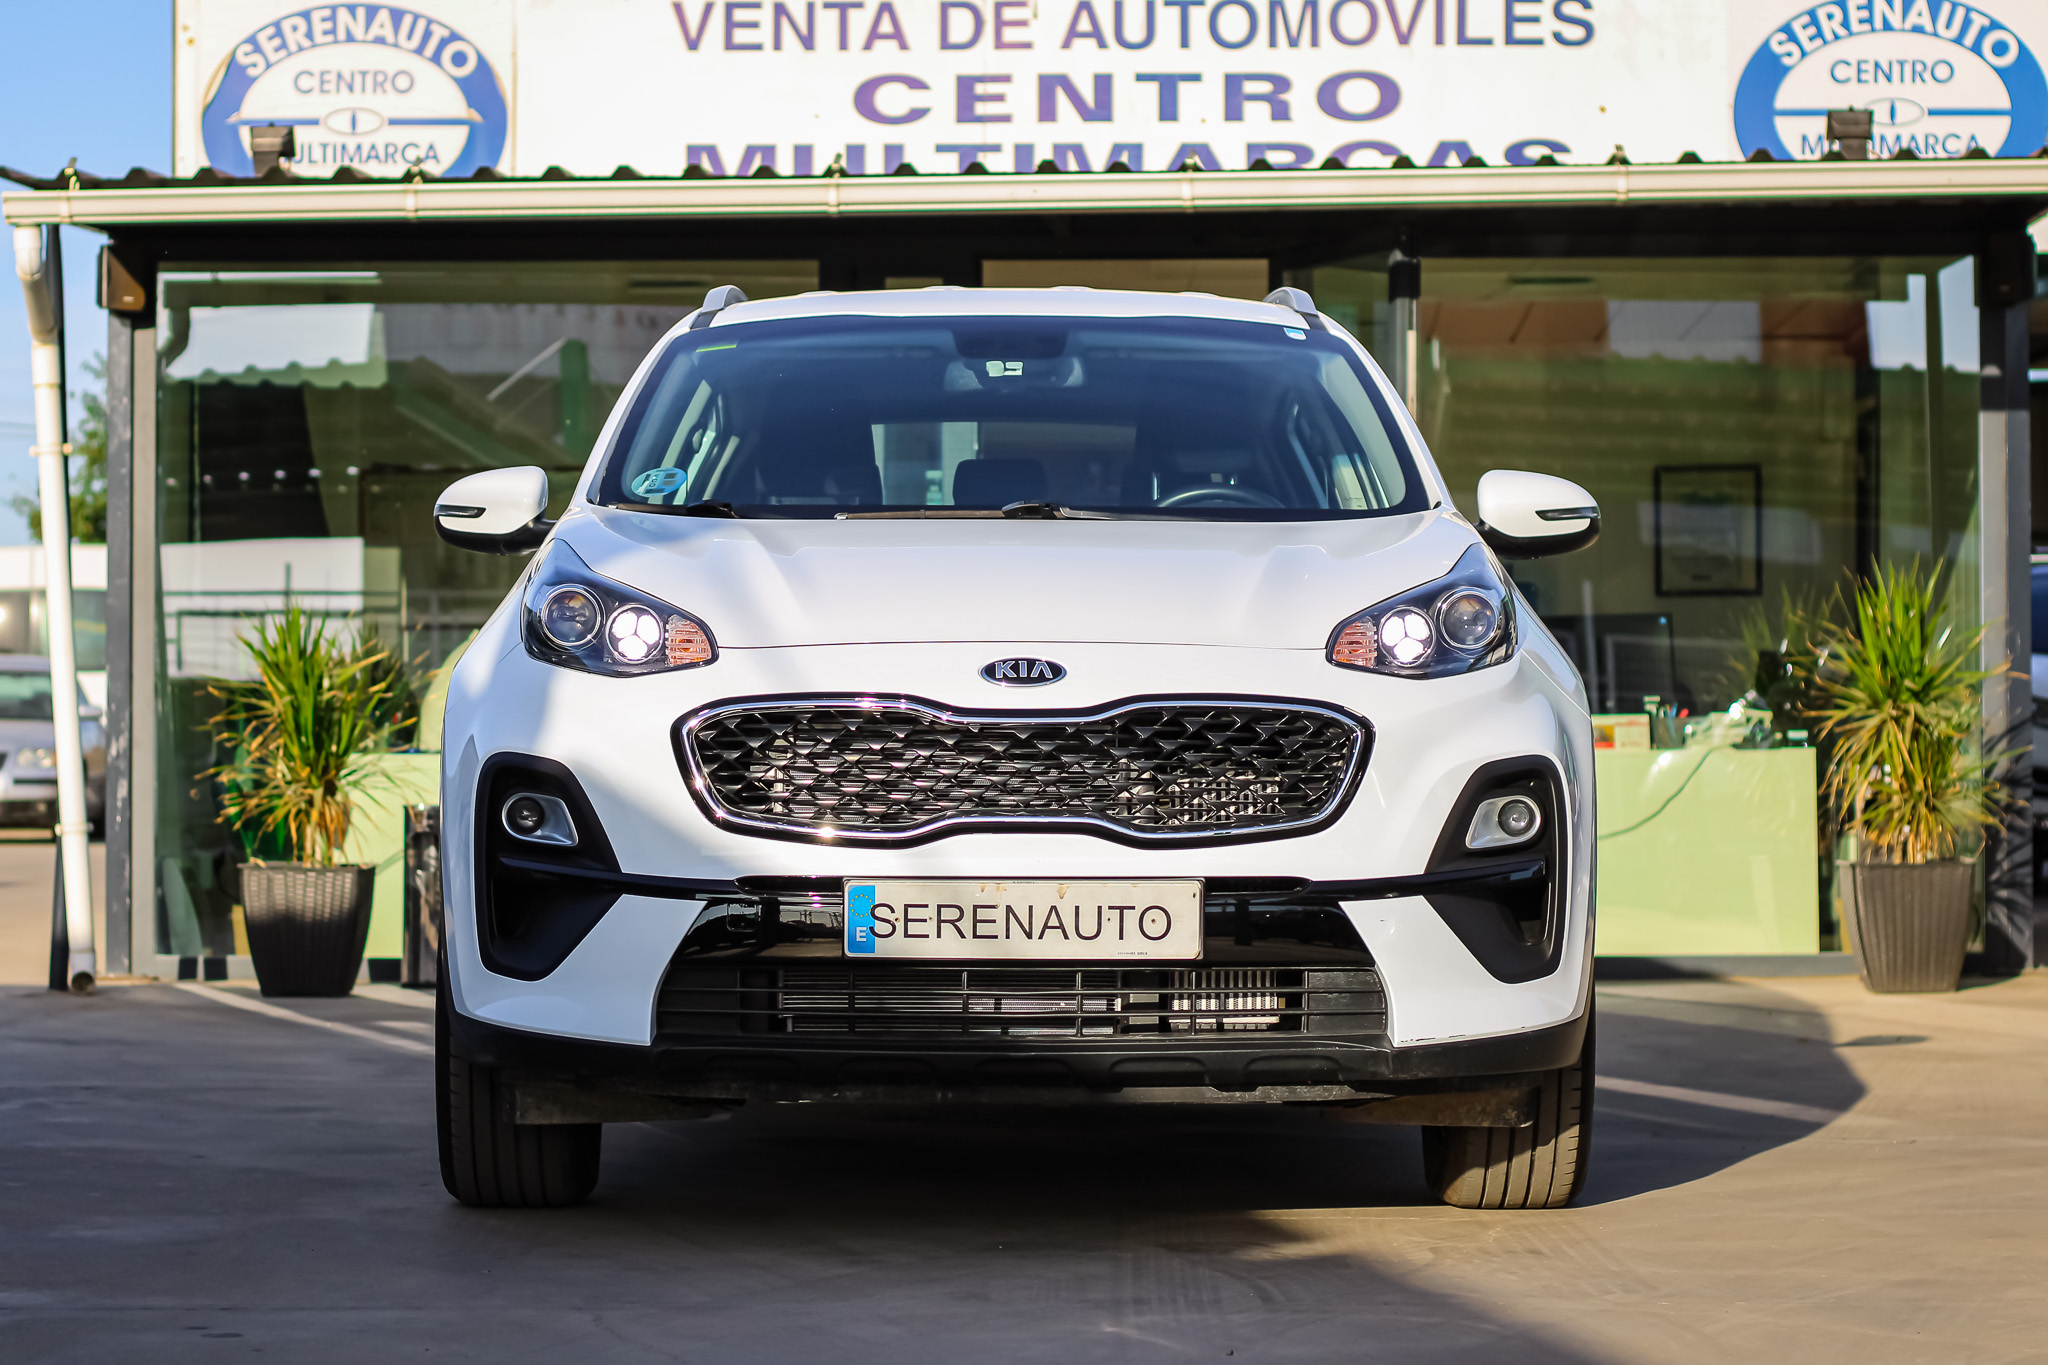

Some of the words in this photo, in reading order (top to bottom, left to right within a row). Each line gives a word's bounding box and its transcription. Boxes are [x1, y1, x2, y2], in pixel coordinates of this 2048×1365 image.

[671, 1, 910, 51] VENTA
[938, 0, 1034, 51] DE
[1060, 0, 1596, 50] AUTOMOVILES
[1768, 0, 2020, 68] SERENAUTO
[235, 5, 478, 78] SERENAUTO
[294, 70, 415, 95] CENTRO
[1830, 59, 1955, 84] CENTRO
[853, 70, 1403, 125] CENTRO
[284, 142, 440, 164] ULTIMARCA
[995, 660, 1053, 679] KIA
[855, 926, 868, 942] E
[868, 903, 1173, 941] SERENAUTO
